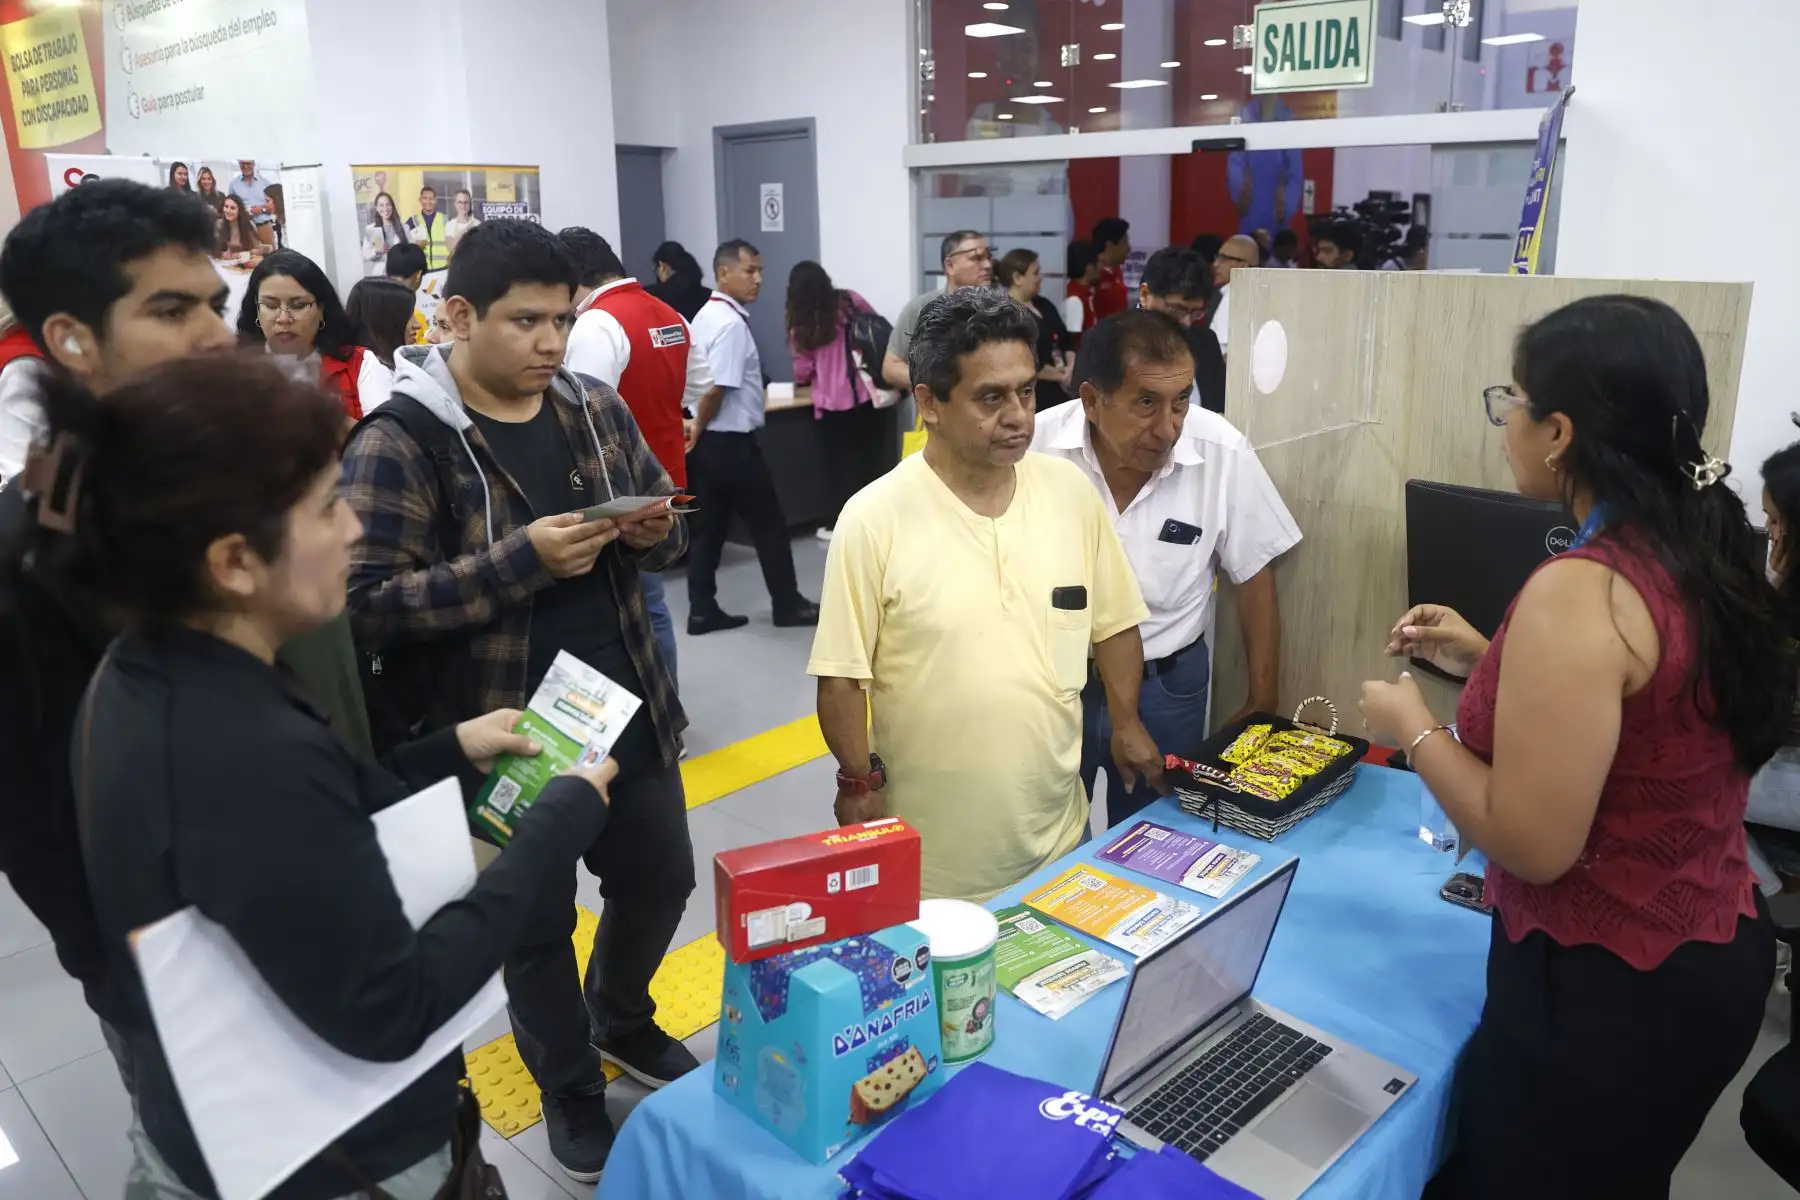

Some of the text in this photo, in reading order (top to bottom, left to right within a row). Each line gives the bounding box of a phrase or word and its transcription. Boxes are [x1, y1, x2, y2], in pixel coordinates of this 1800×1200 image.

[11, 32, 78, 73] BOLSA DE TRABAJO
[164, 43, 182, 66] para
[181, 36, 190, 54] la
[189, 24, 228, 52] búsqueda
[228, 16, 242, 39] del
[242, 8, 277, 36] empleo
[1263, 16, 1360, 74] SALIDA
[21, 64, 78, 97] PARA PERSONAS
[21, 94, 89, 126] CON DISCAPACIDAD
[158, 94, 174, 114] para
[174, 83, 204, 110] postular
[482, 206, 513, 214] EQUIPO
